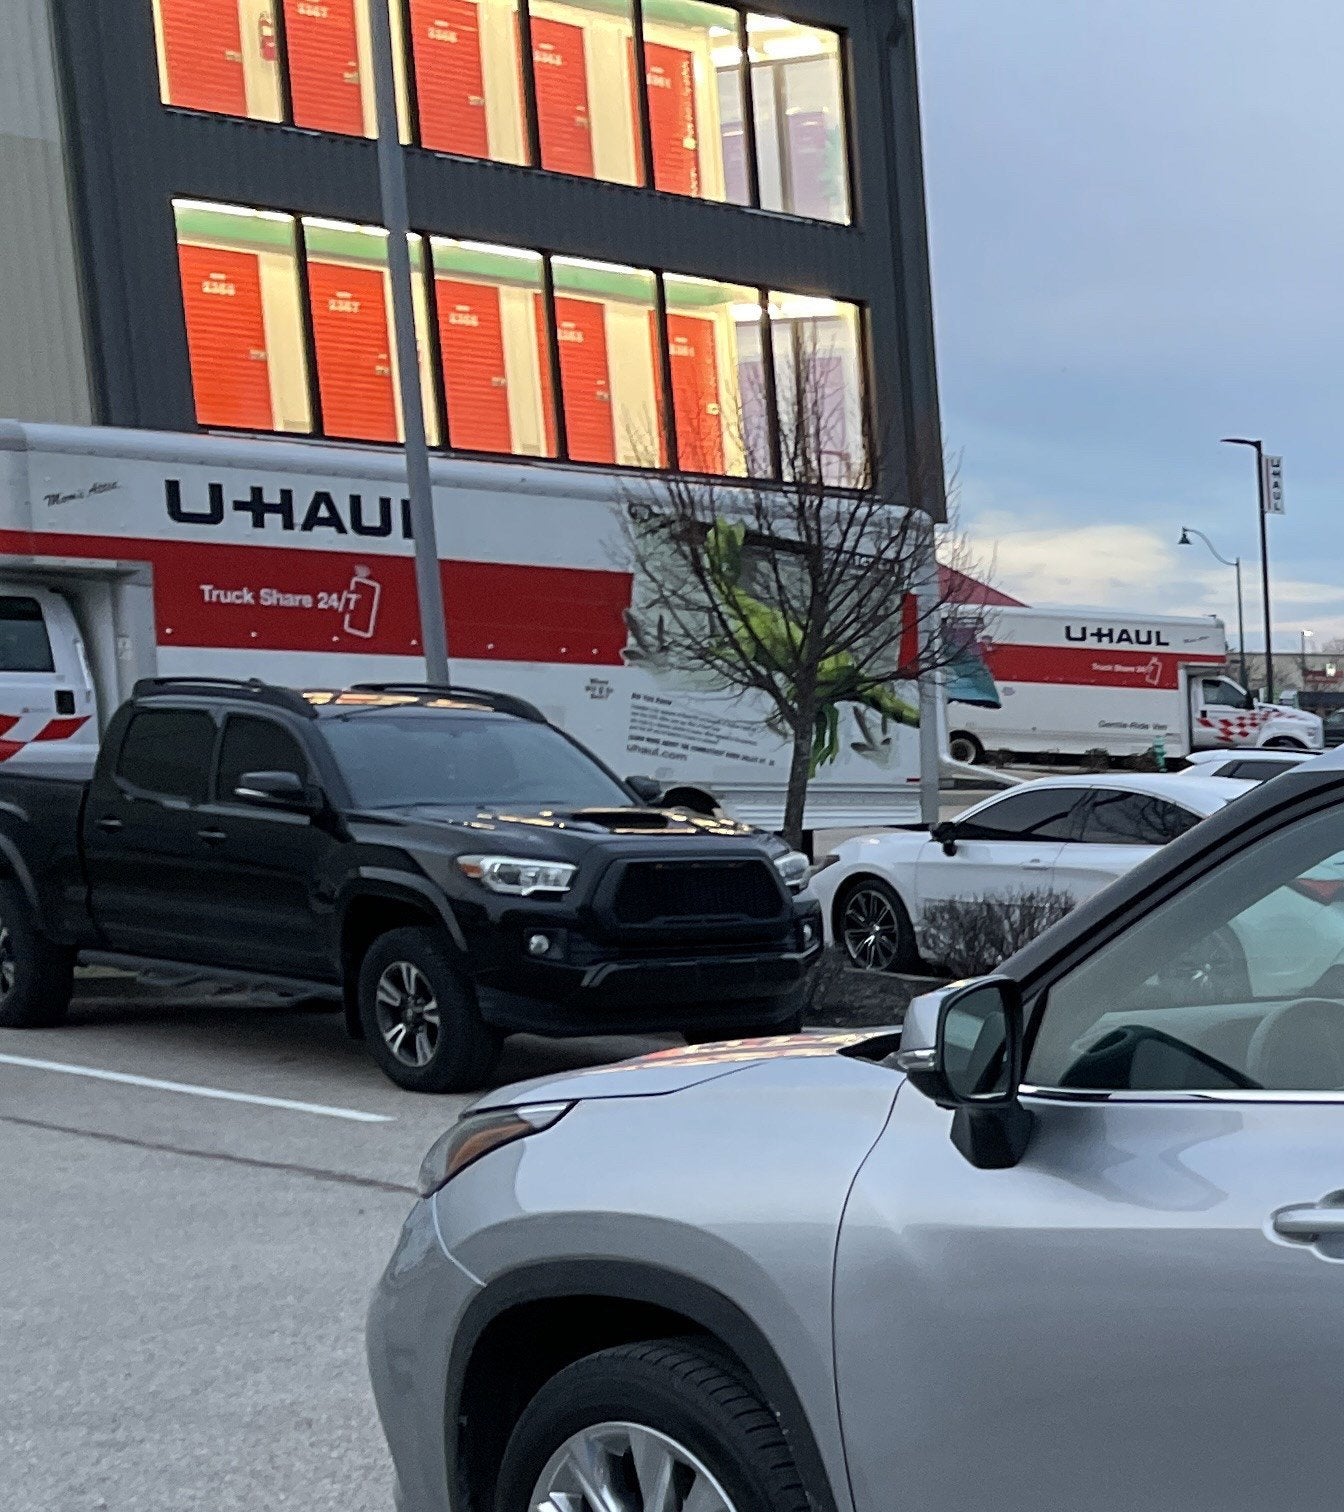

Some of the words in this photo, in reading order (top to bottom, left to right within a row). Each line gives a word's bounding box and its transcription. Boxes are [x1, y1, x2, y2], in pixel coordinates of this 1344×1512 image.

[201, 584, 255, 605] Truck
[259, 588, 313, 609] Share
[317, 589, 362, 614] 24/7
[1064, 625, 1170, 647] U-HAUL
